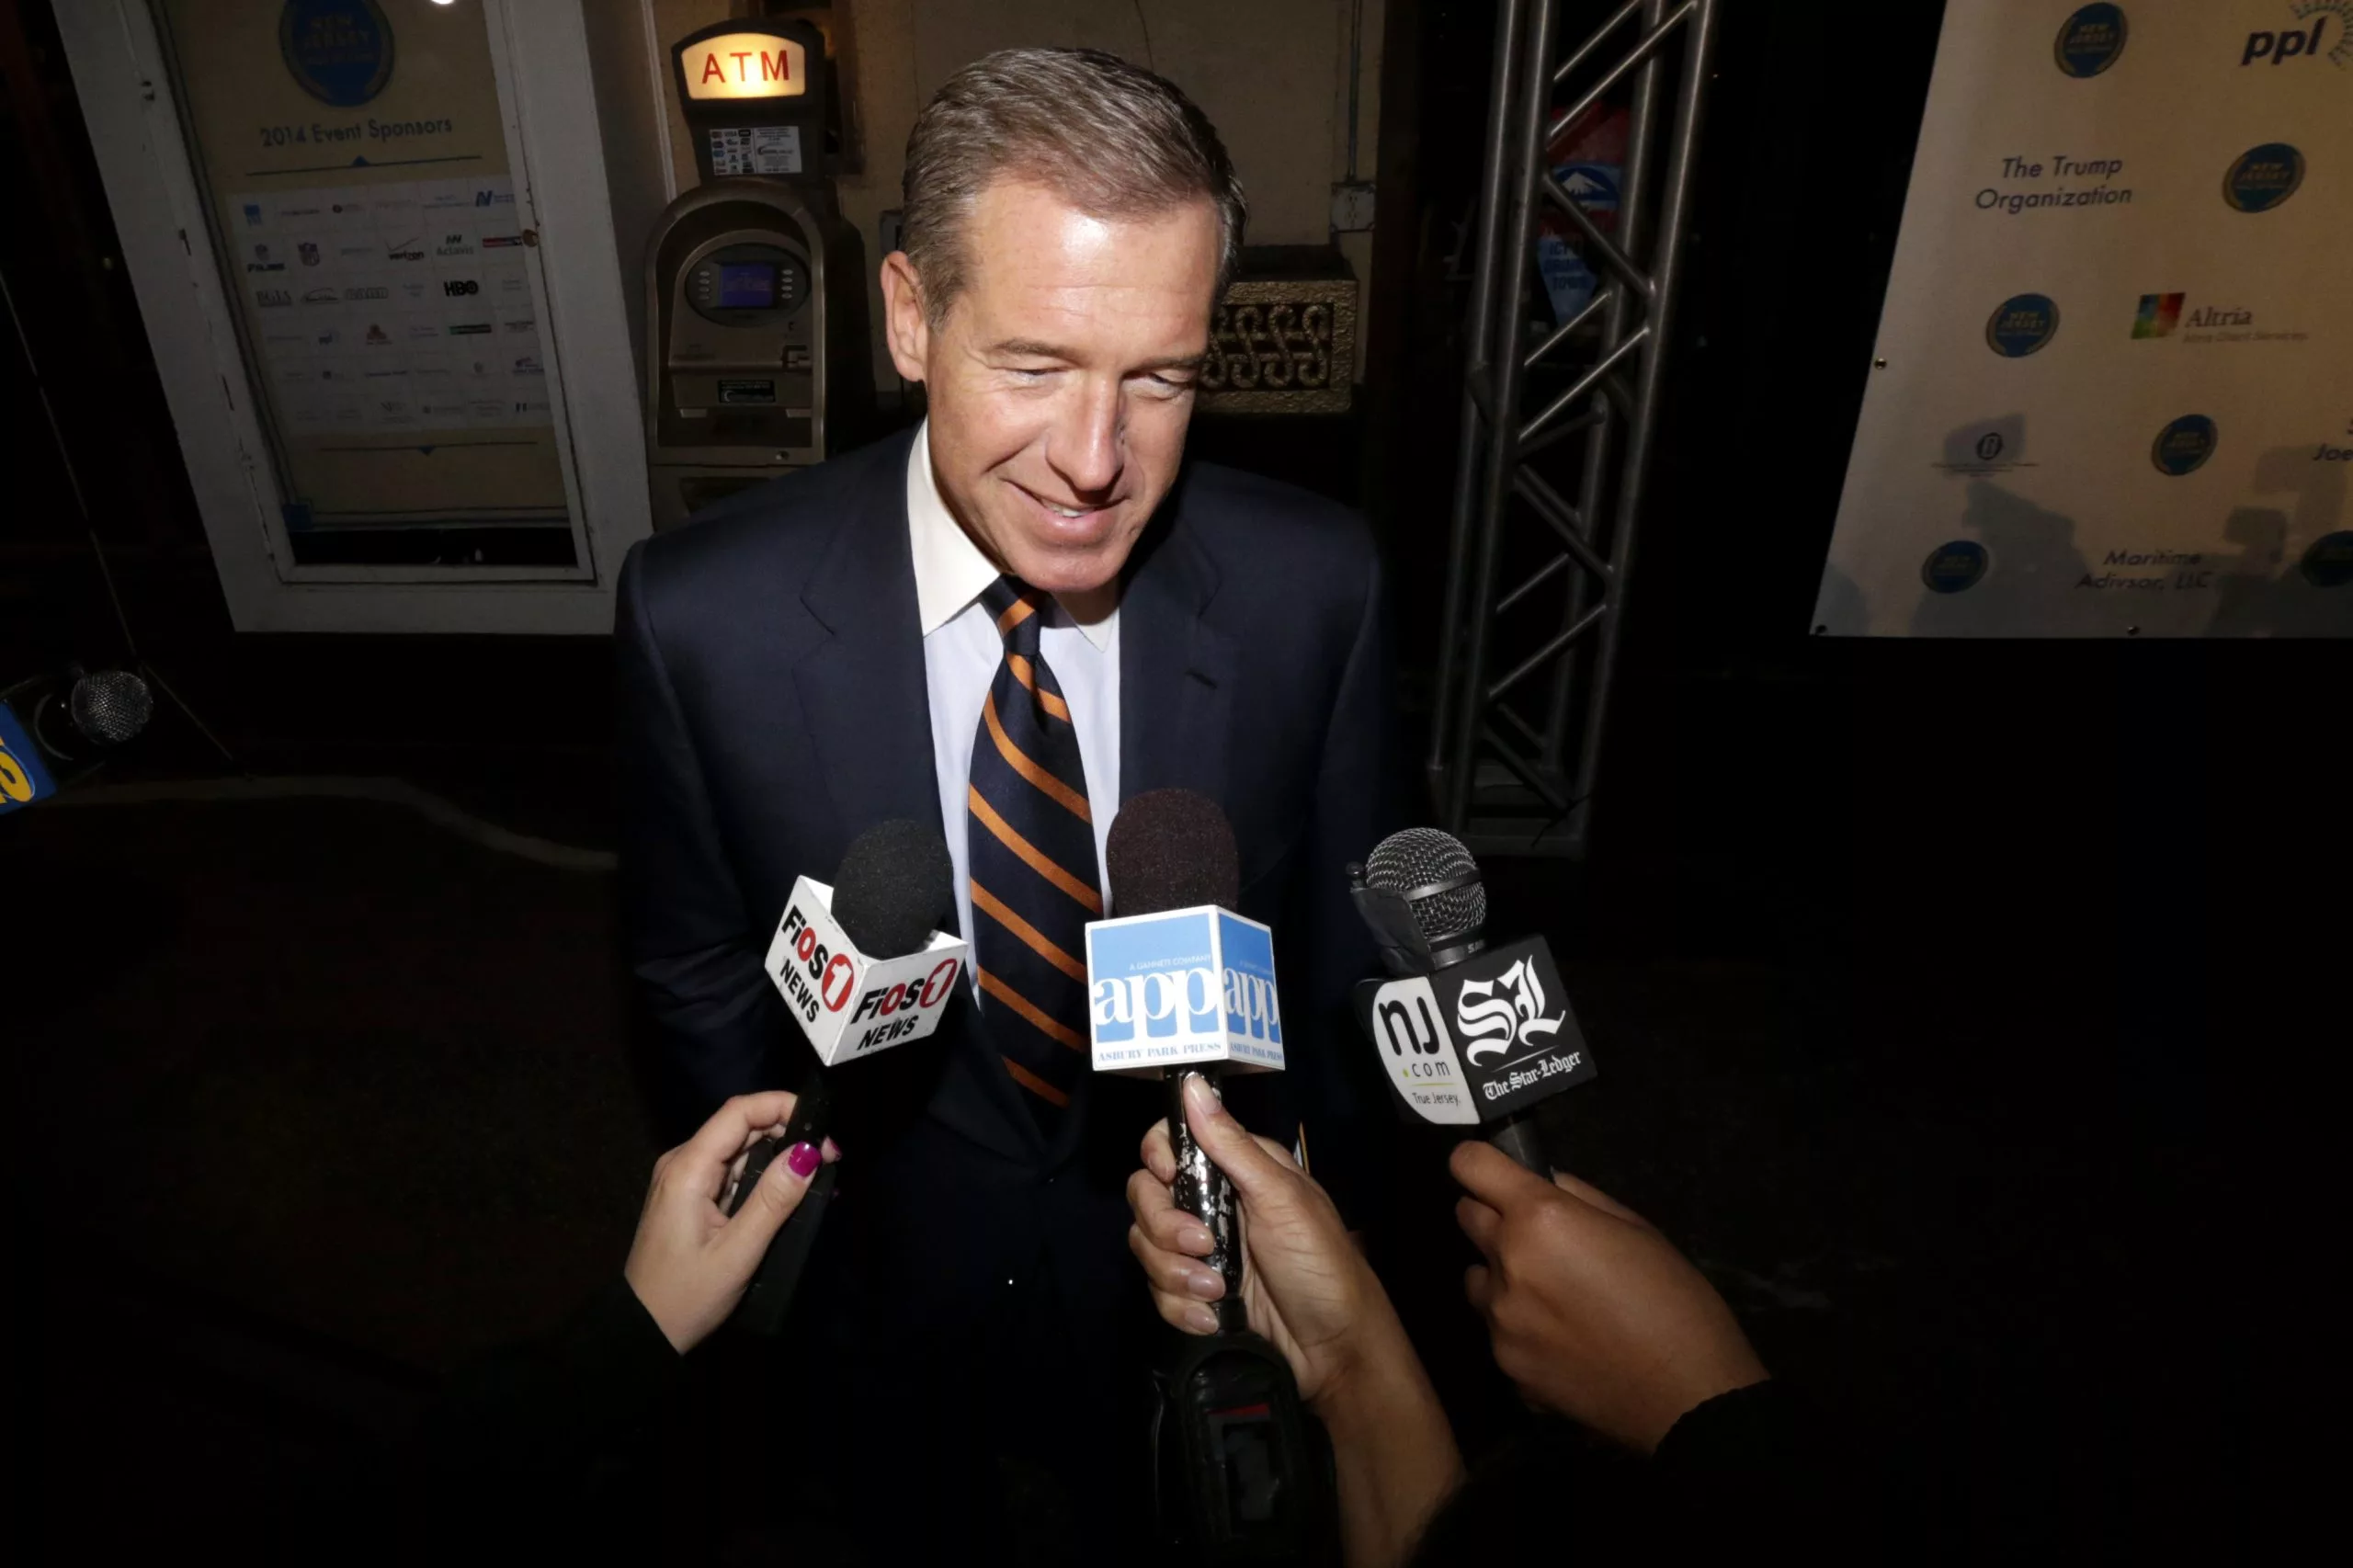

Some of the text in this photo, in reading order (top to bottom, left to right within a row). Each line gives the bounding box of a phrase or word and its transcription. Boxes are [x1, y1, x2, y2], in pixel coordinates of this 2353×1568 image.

[2241, 15, 2327, 66] ppl
[701, 50, 790, 85] ATM
[260, 119, 452, 147] 2014 Event Sponsors
[2002, 156, 2122, 180] The Trump
[1976, 184, 2132, 214] Organization
[443, 279, 480, 297] HBO
[2185, 306, 2253, 328] Altria
[2103, 549, 2202, 566] Maritime
[1173, 954, 1211, 966] COMPANY
[780, 960, 820, 1023] NEWS
[1092, 967, 1219, 1039] app
[1223, 967, 1280, 1043] app
[857, 1015, 918, 1051] NEWS
[1097, 1042, 1222, 1062] ASBURY PARK PRESS
[1483, 1051, 1581, 1101] The Star-Ledger
[1412, 1092, 1431, 1104] True
